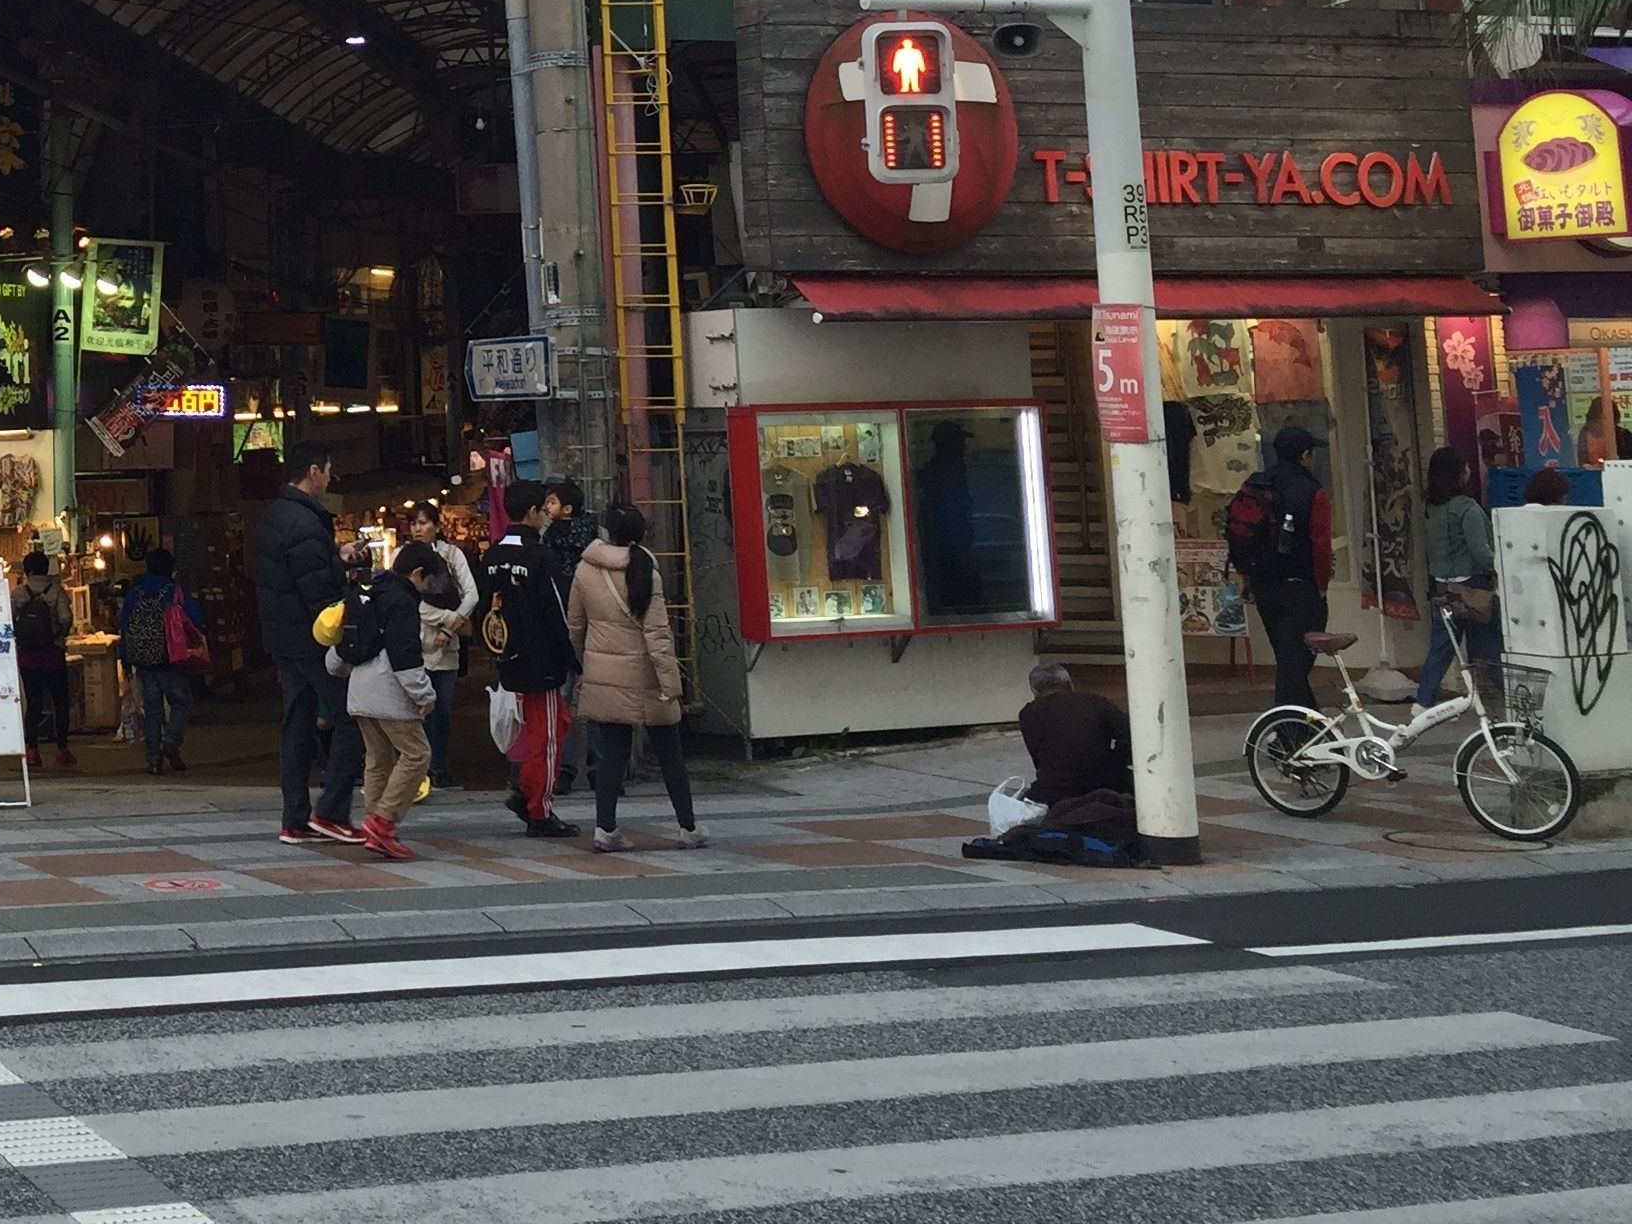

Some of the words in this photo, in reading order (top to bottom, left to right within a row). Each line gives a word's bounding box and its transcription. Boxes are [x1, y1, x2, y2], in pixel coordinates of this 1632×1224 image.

[1122, 183, 1145, 204] 39
[1123, 204, 1147, 224] R5
[1518, 200, 1616, 232] 御菓子御殿
[1126, 225, 1149, 245] P3
[53, 309, 71, 324] A
[54, 327, 70, 341] 2
[481, 347, 537, 374] 平和通り
[1098, 349, 1114, 393] 5
[1119, 378, 1139, 395] m
